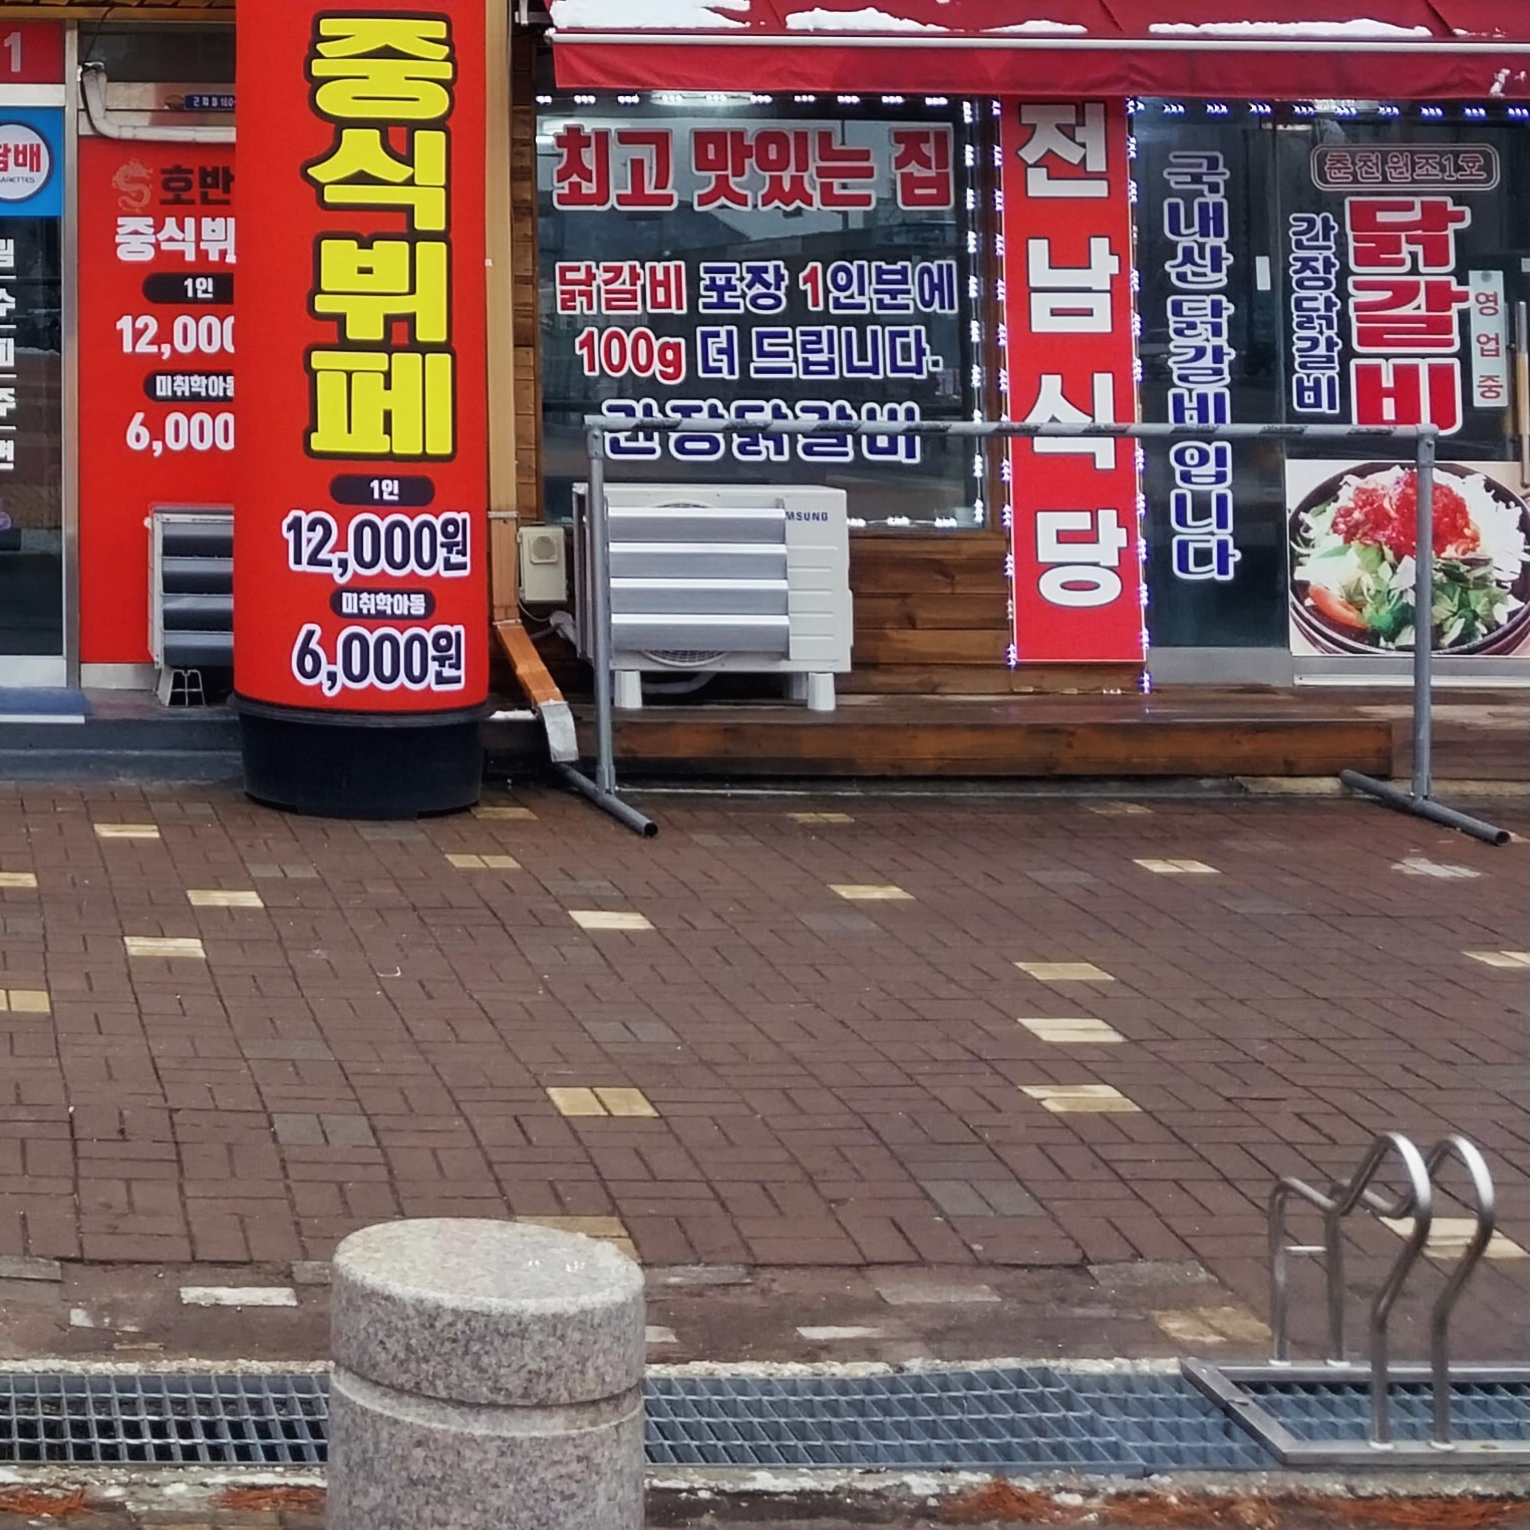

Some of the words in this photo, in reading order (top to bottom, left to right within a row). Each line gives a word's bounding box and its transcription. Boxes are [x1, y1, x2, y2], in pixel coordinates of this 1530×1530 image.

[159, 164, 235, 205] 호반
[553, 123, 678, 211] 최고
[692, 127, 877, 211] 맛있는
[891, 128, 955, 211] 집
[1324, 152, 1487, 182] 춘천원조1호
[115, 216, 237, 264] 중식뷔
[304, 14, 456, 459] 중식뷔페
[1164, 150, 1234, 290] 국내산
[183, 277, 214, 298] 1인
[555, 260, 687, 315] 닭갈비
[698, 260, 788, 315] 포장
[799, 260, 958, 315] 1인분에
[1289, 212, 1342, 413] 간장닭갈비
[1345, 196, 1471, 436] 닭갈비
[575, 326, 686, 385] 100g
[696, 325, 739, 379] 더
[750, 325, 943, 380] 드립니다.
[1018, 101, 1128, 608] 전남식당
[1166, 293, 1235, 427] 닭갈비
[126, 412, 235, 457] 6,000
[601, 398, 921, 464] 간장닭갈비
[370, 479, 399, 500] 1인
[1170, 440, 1241, 581] 입니다
[282, 510, 470, 584] 12,000원
[342, 592, 426, 615] 미취학아동
[292, 623, 465, 697] 6,000원
